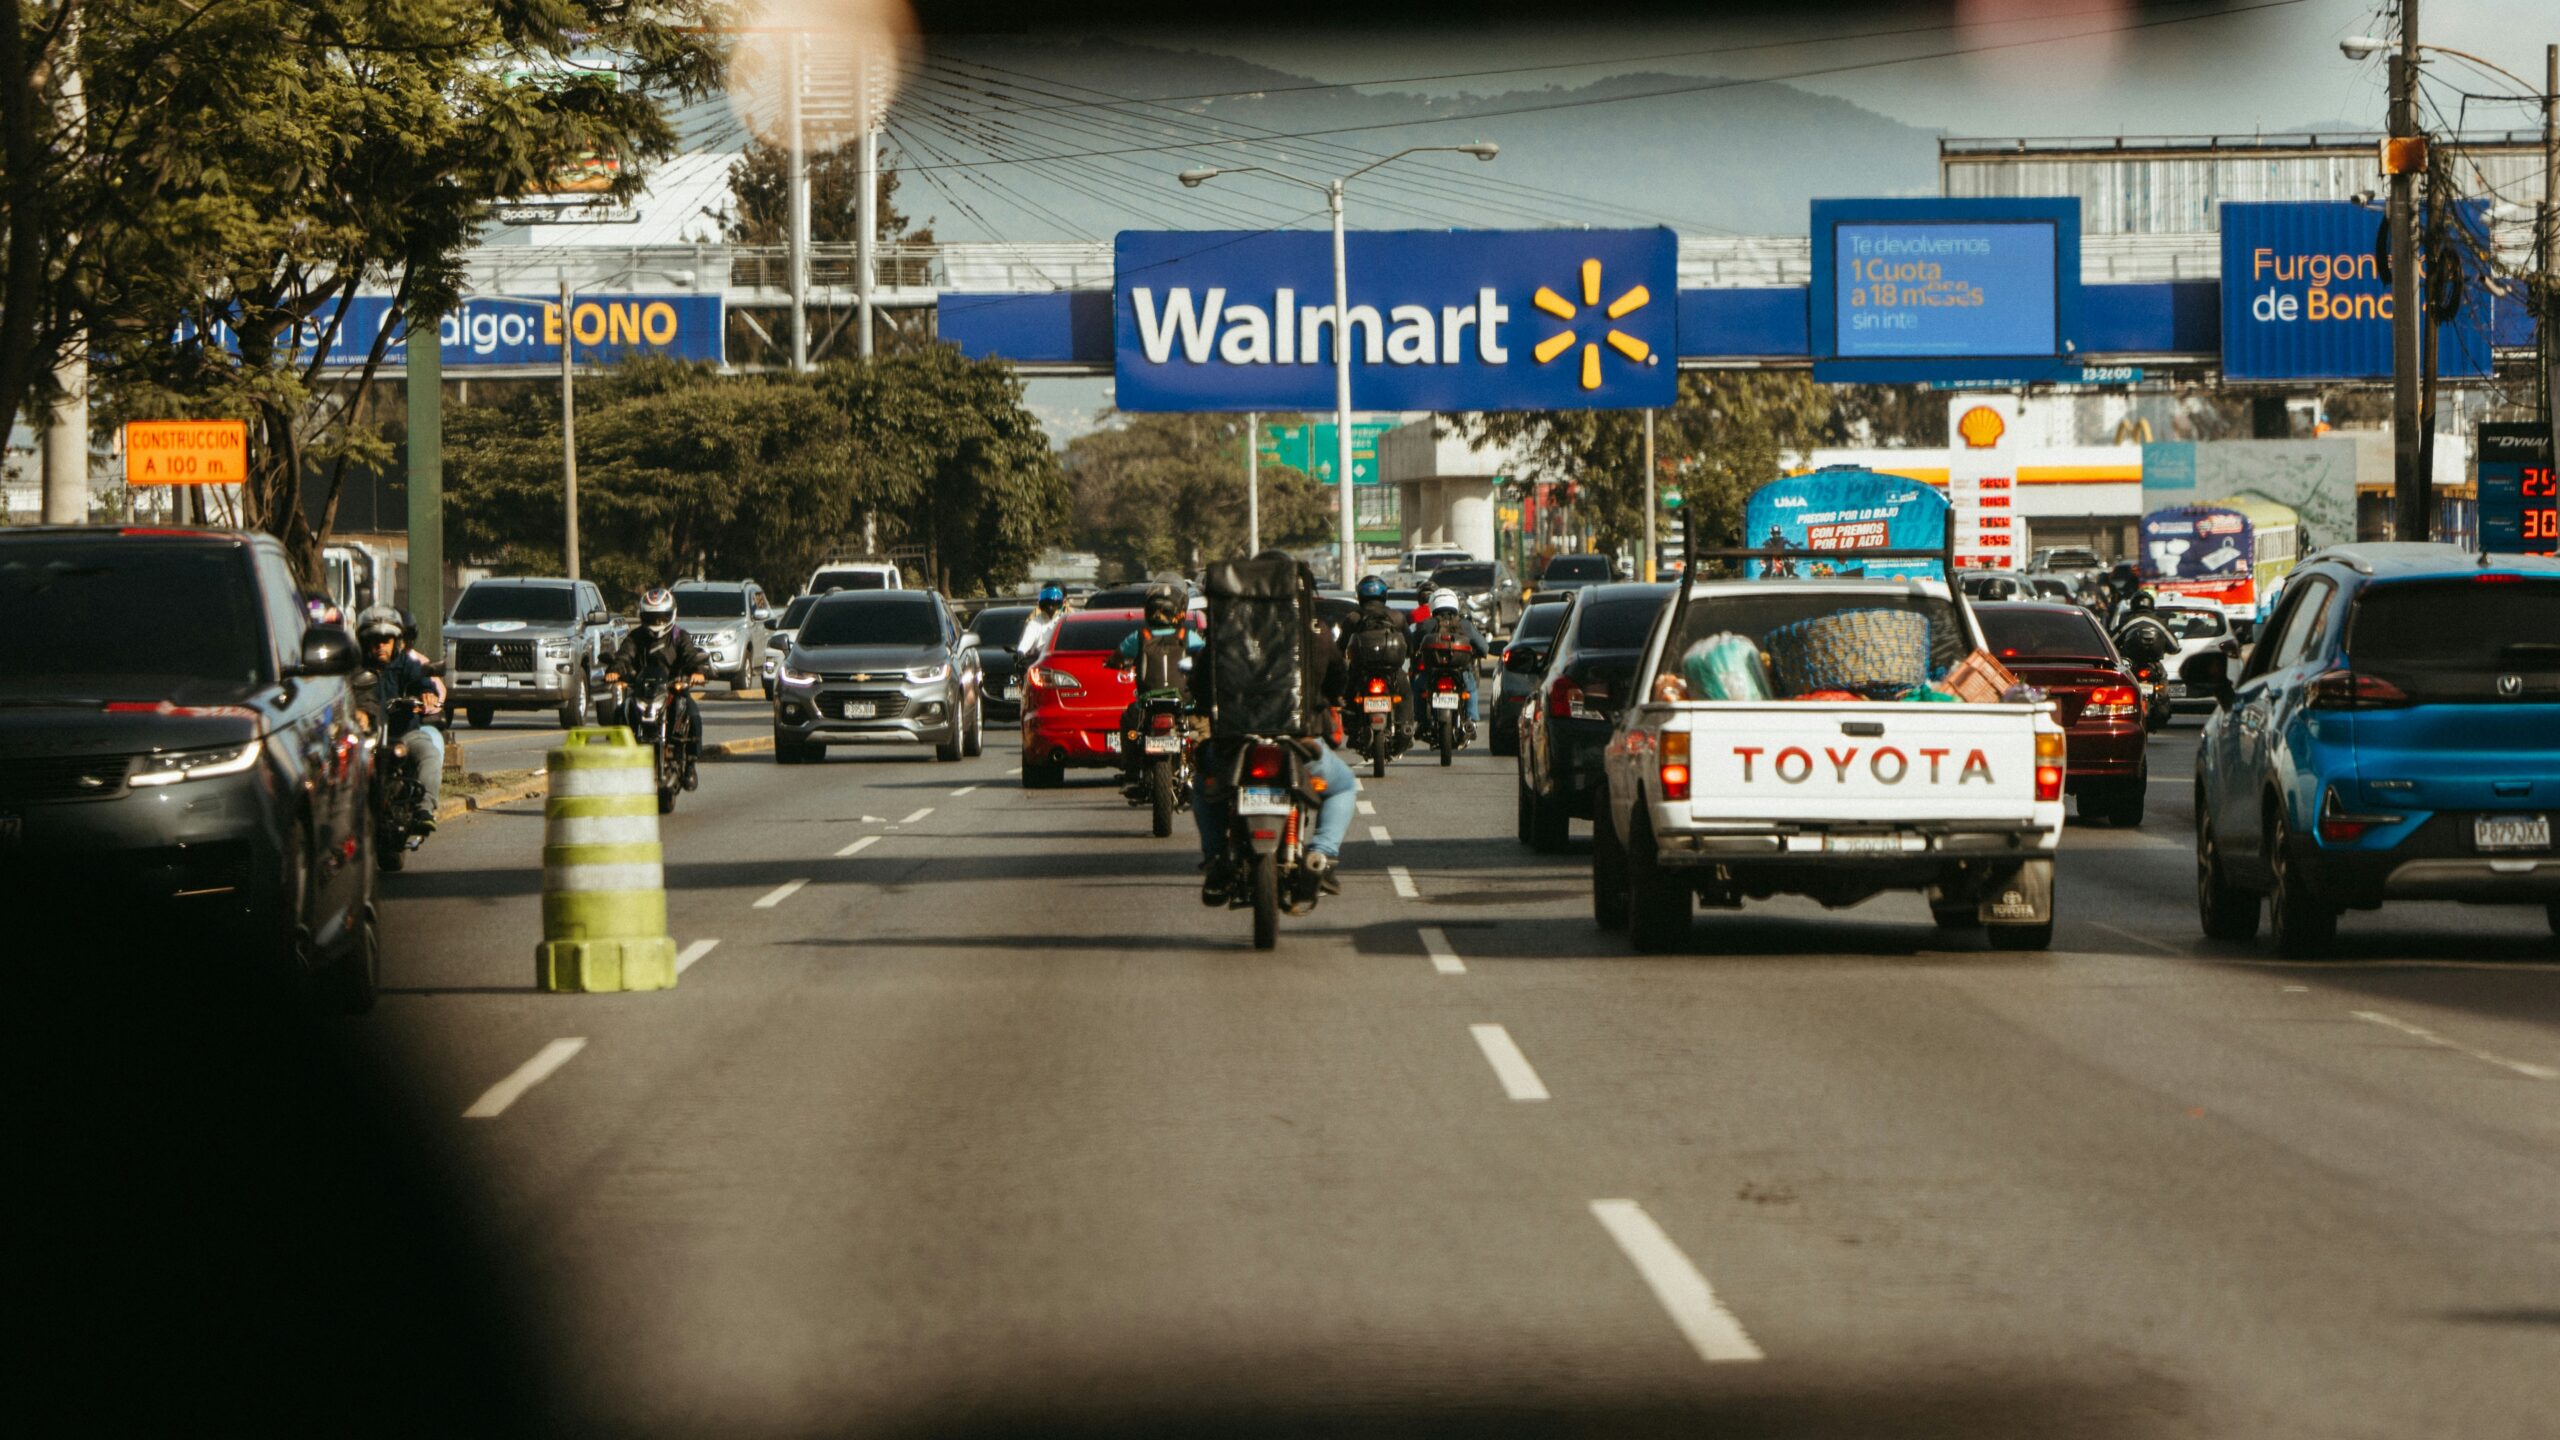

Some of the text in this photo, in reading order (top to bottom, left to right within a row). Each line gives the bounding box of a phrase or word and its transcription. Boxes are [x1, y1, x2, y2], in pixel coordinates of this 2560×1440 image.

[1851, 234, 1990, 255] Te devolvemos
[1852, 258, 1942, 281] 1 Cuota
[1851, 288, 1866, 307] a
[1871, 284, 1897, 308] 18
[2252, 286, 2299, 321] de
[543, 301, 678, 346] BONO
[1131, 286, 1510, 365] Walmart
[1852, 311, 1880, 330] sin
[132, 430, 240, 449] CONSTRUCCION
[145, 456, 156, 474] A
[167, 456, 197, 474] 100
[1796, 511, 1837, 524] PRECIOS
[1837, 509, 1859, 521] POR
[1859, 508, 1873, 519] LO
[1872, 507, 1899, 518] BAJO
[2523, 509, 2557, 537] 30
[1811, 522, 1884, 539] CON PREMIOS
[1813, 535, 1884, 549] POR LO ALTO
[1733, 745, 1996, 785] TOYOTA
[2478, 823, 2546, 843] P879JXX
[1992, 904, 2035, 917] TOYOTA
